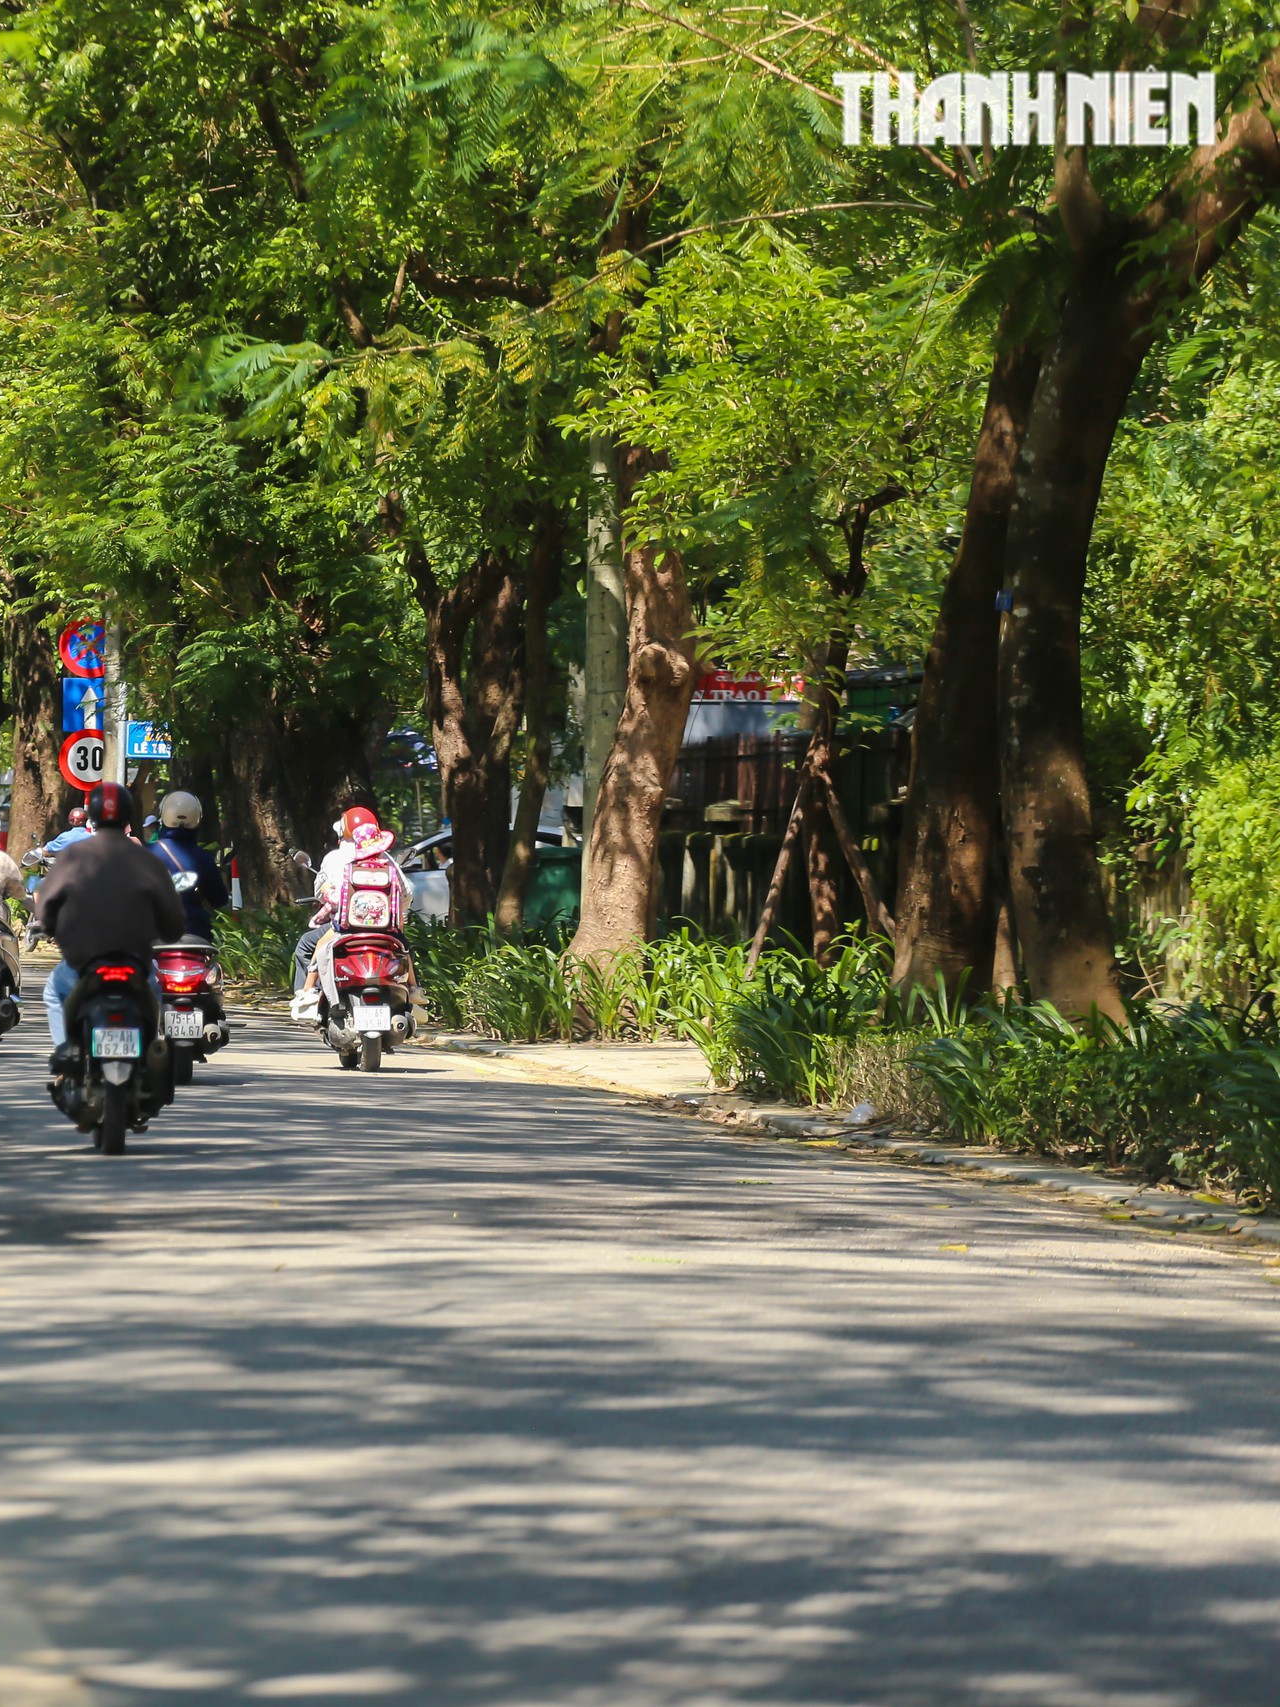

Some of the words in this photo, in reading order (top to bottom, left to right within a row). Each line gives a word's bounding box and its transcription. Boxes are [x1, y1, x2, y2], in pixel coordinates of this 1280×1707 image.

[710, 689, 759, 700] TRAO
[152, 742, 171, 754] TR
[76, 745, 104, 772] 30
[170, 1013, 196, 1024] 75-F1
[100, 1030, 132, 1042] 75-AH
[168, 1025, 200, 1037] 334.67
[96, 1043, 137, 1056] 062.84
